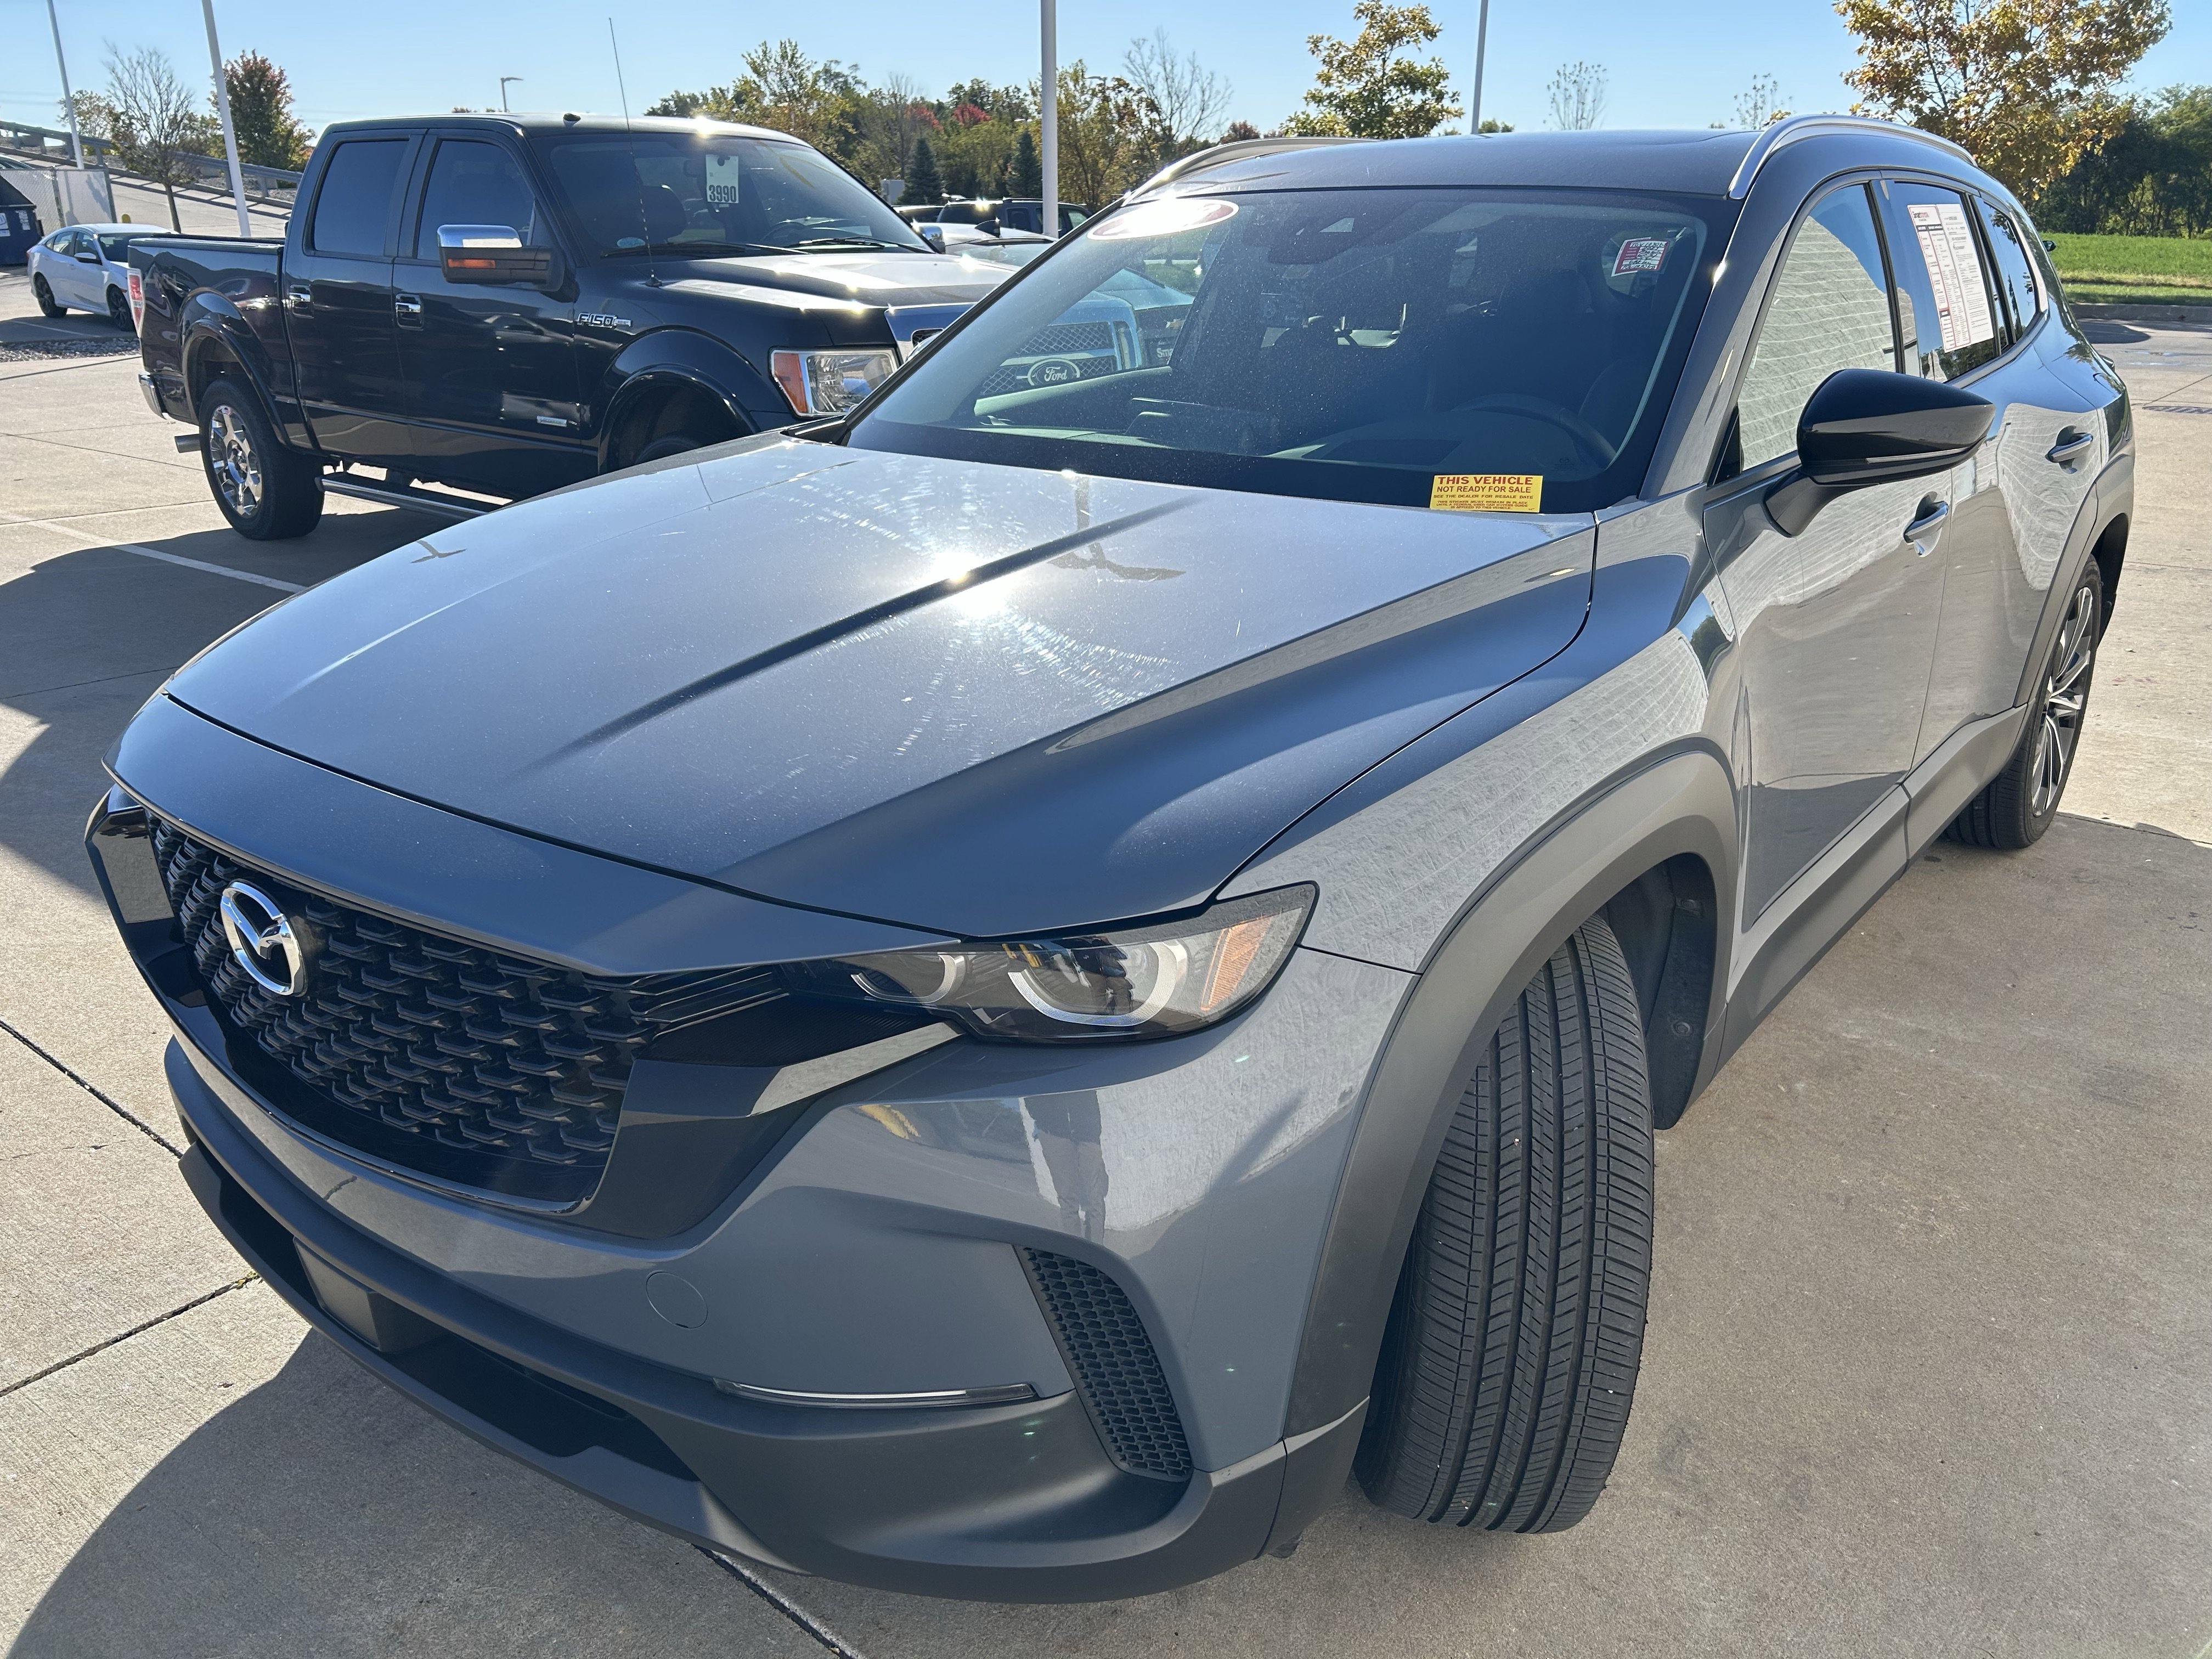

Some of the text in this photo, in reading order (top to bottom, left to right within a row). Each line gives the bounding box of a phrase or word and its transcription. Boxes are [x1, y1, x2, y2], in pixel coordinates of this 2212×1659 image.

[709, 184, 737, 202] 3990
[1044, 366, 1067, 381] Ford
[1438, 476, 1533, 485] THIS VEHICLE
